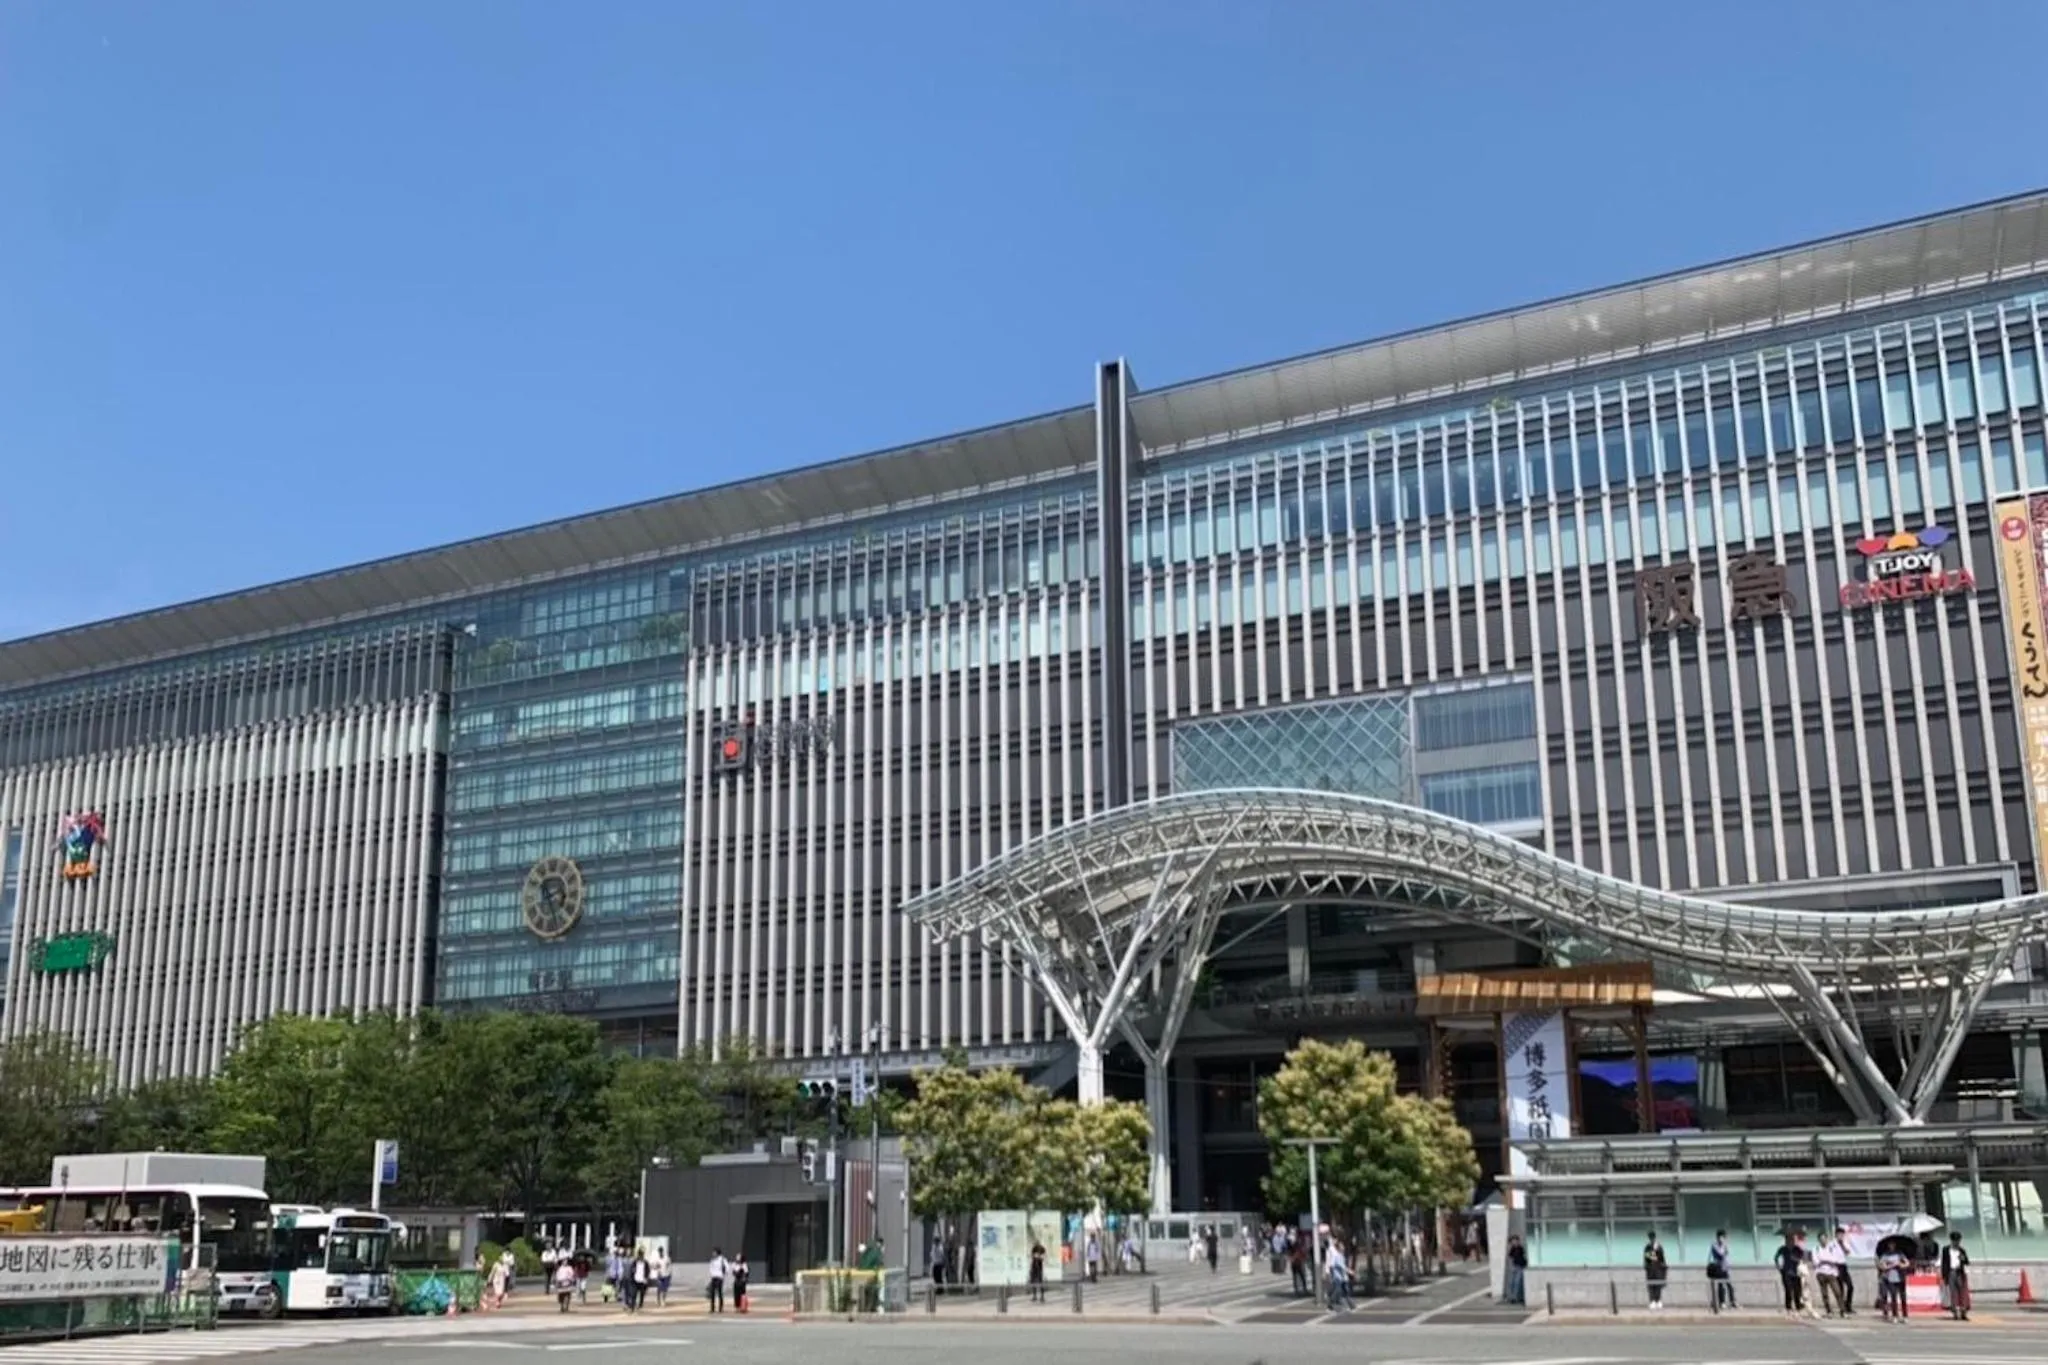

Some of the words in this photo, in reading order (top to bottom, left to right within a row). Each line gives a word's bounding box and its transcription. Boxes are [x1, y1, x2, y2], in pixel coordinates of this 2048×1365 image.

[1636, 552, 1796, 637] 阪急
[1840, 567, 1977, 608] CINEMA
[2021, 621, 2048, 699] くうてん
